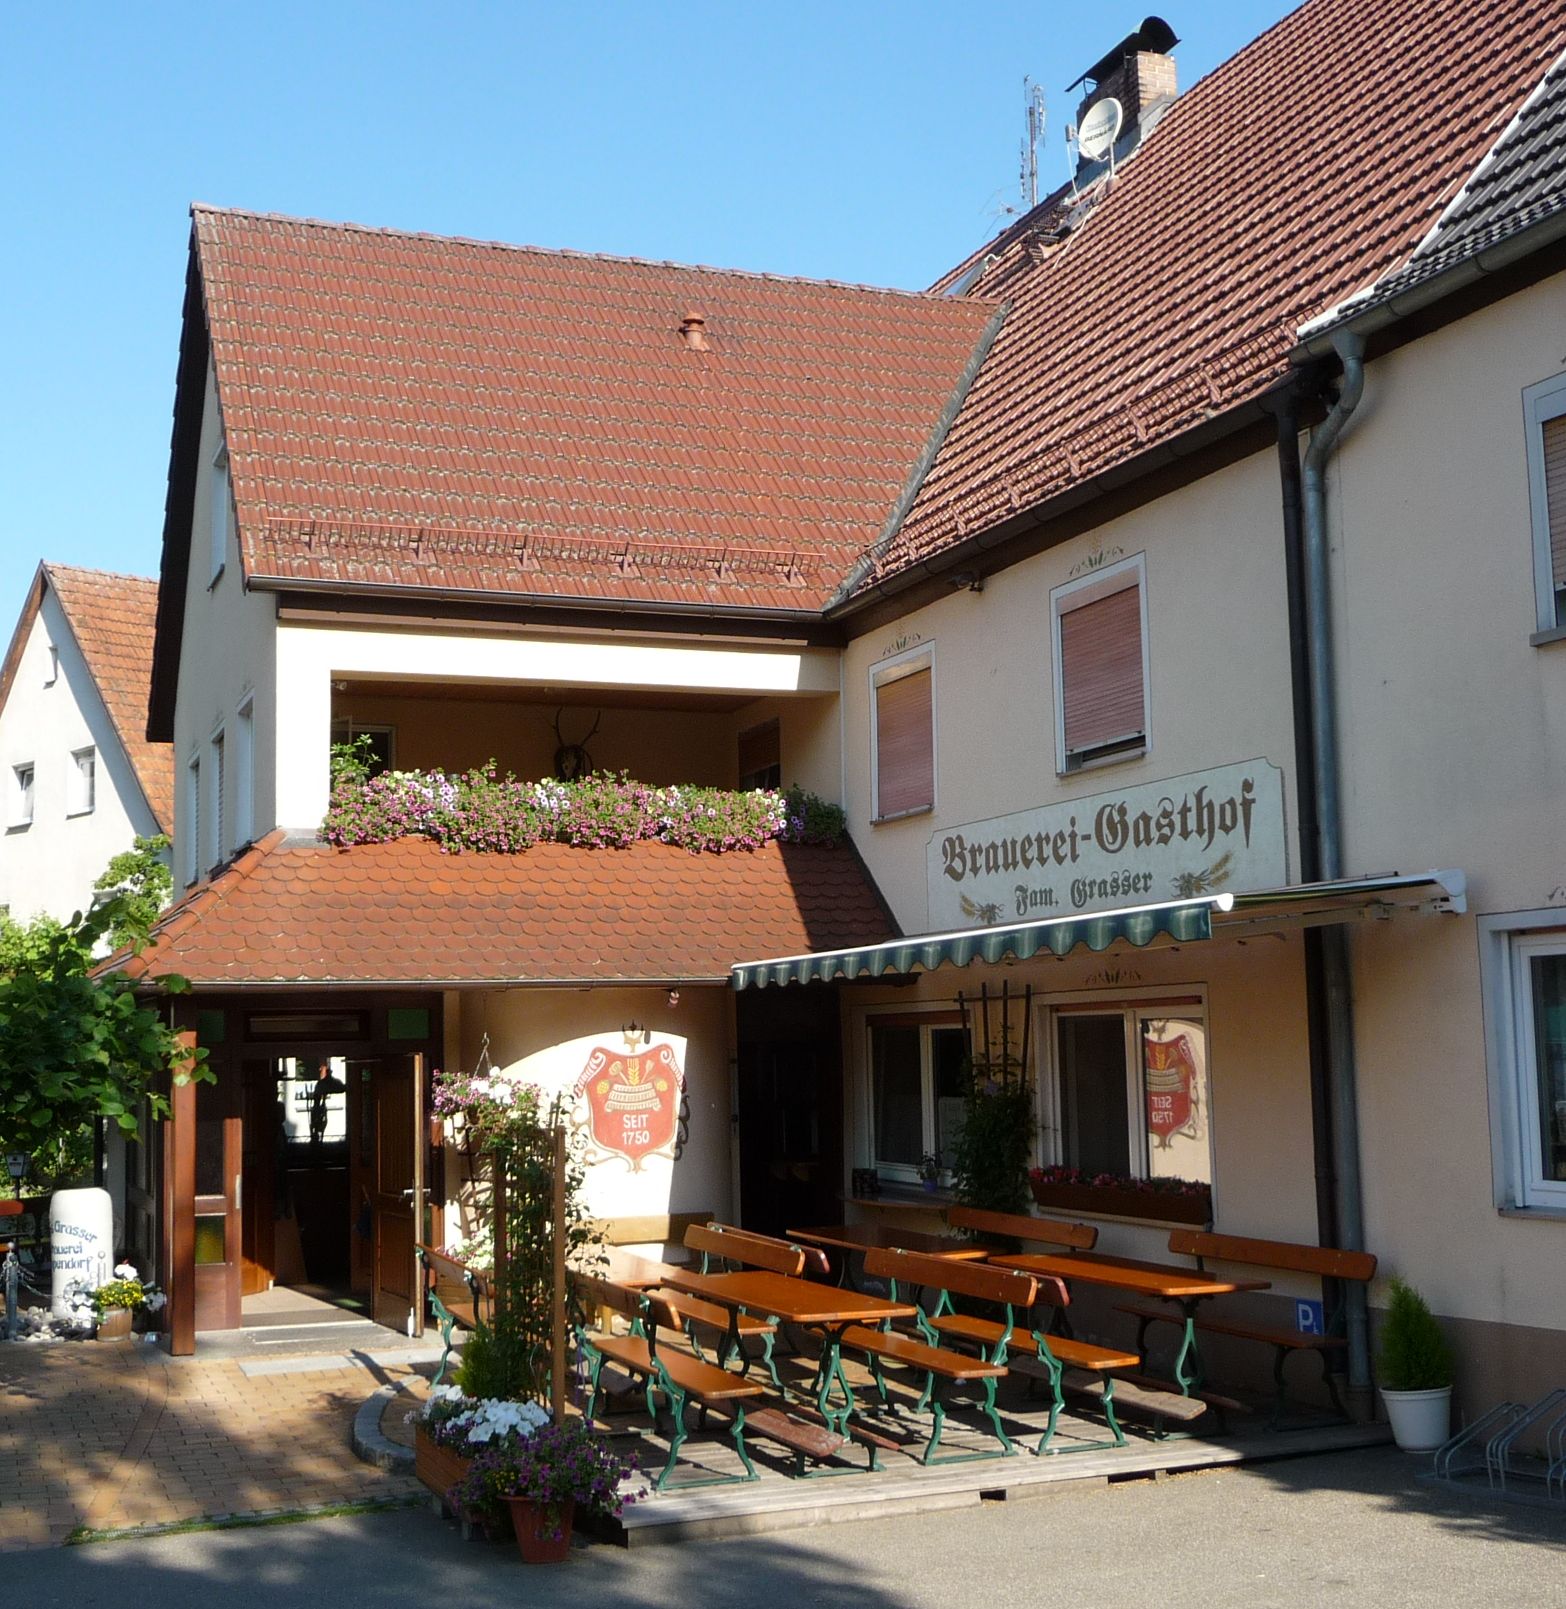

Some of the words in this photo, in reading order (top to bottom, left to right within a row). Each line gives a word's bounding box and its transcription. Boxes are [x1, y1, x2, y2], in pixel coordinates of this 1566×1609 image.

[942, 777, 1256, 882] Brauerei-Gasthof
[1014, 883, 1059, 916] Fam.
[1070, 868, 1153, 908] Grasser
[622, 1113, 649, 1129] SEIT
[622, 1130, 650, 1145] 1750
[54, 1220, 98, 1243] Grasser
[51, 1256, 93, 1273] pendorf
[1298, 1303, 1313, 1333] P
